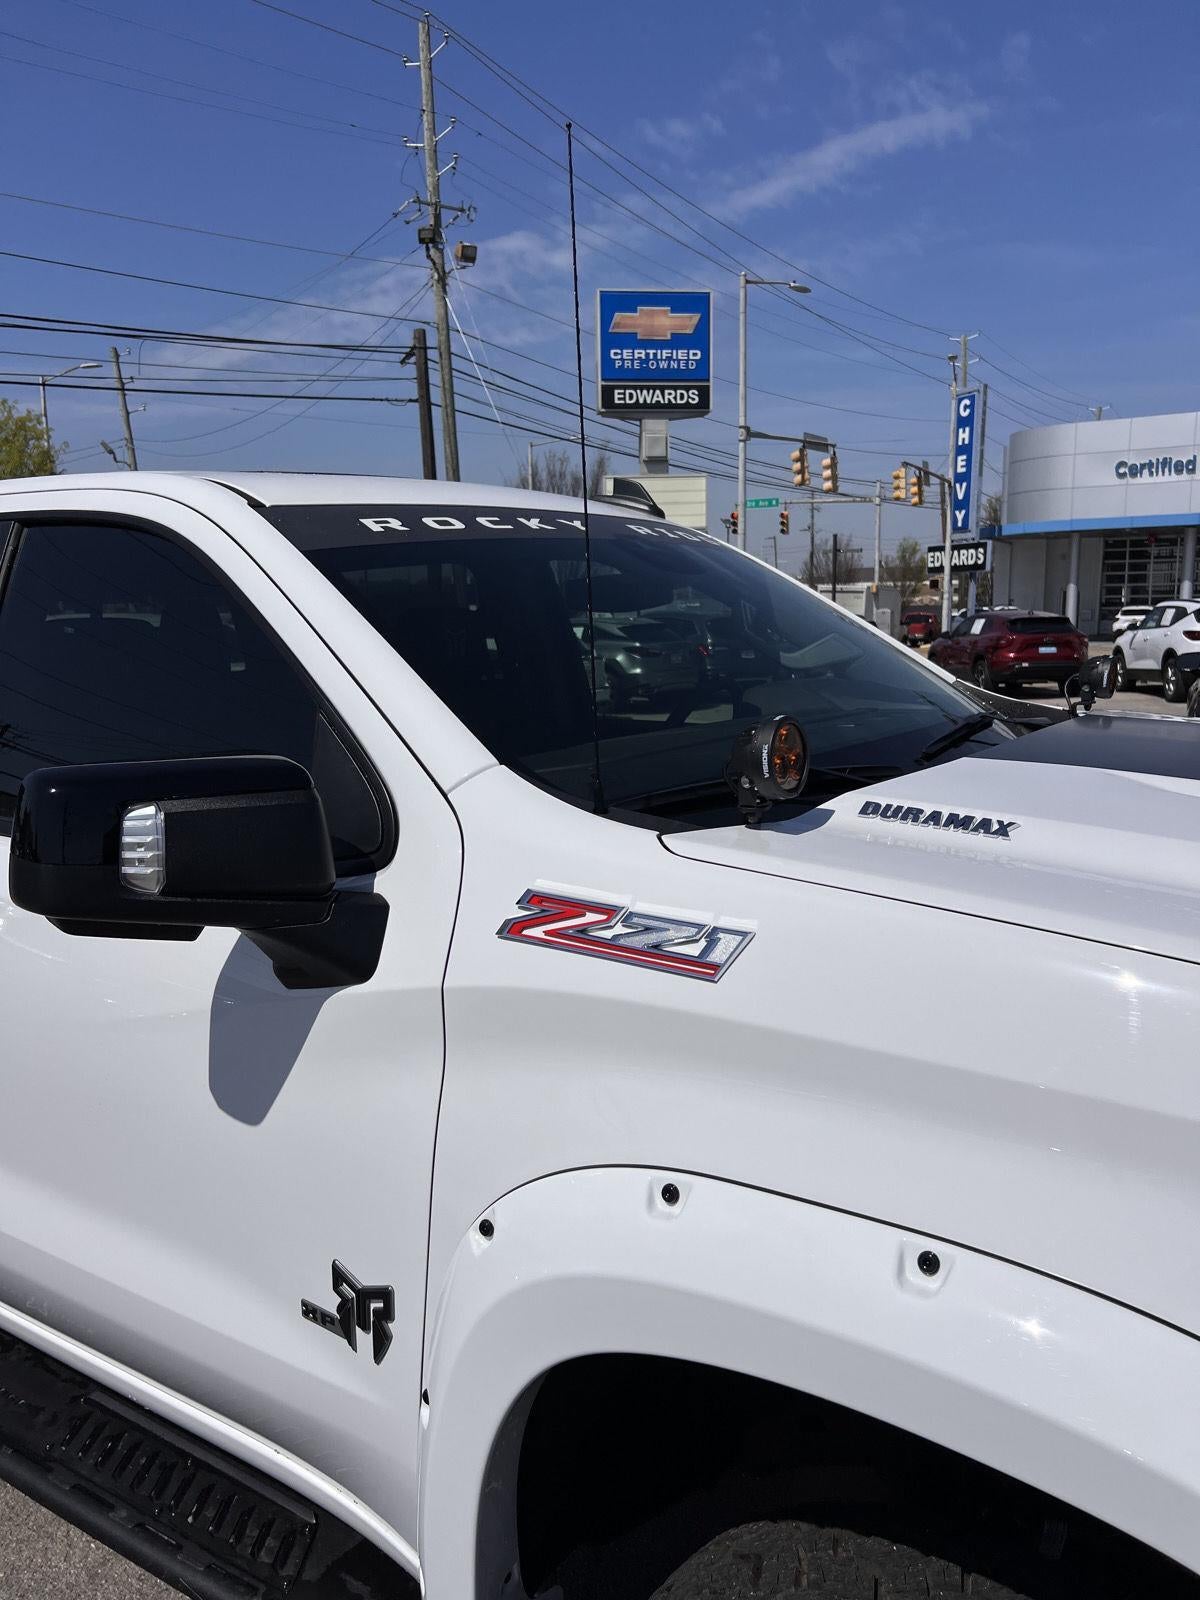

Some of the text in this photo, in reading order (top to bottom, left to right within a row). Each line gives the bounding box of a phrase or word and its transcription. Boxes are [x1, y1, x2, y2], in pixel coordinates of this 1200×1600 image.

[609, 349, 702, 360] CERTIFIED
[615, 360, 697, 370] PRE-OWNED
[613, 389, 700, 405] EDWARDS
[954, 397, 971, 528] CHEVY
[1114, 455, 1198, 480] Certified
[358, 516, 587, 532] ROCKY
[857, 800, 1020, 841] DURAMAX
[495, 887, 756, 985] Z71
